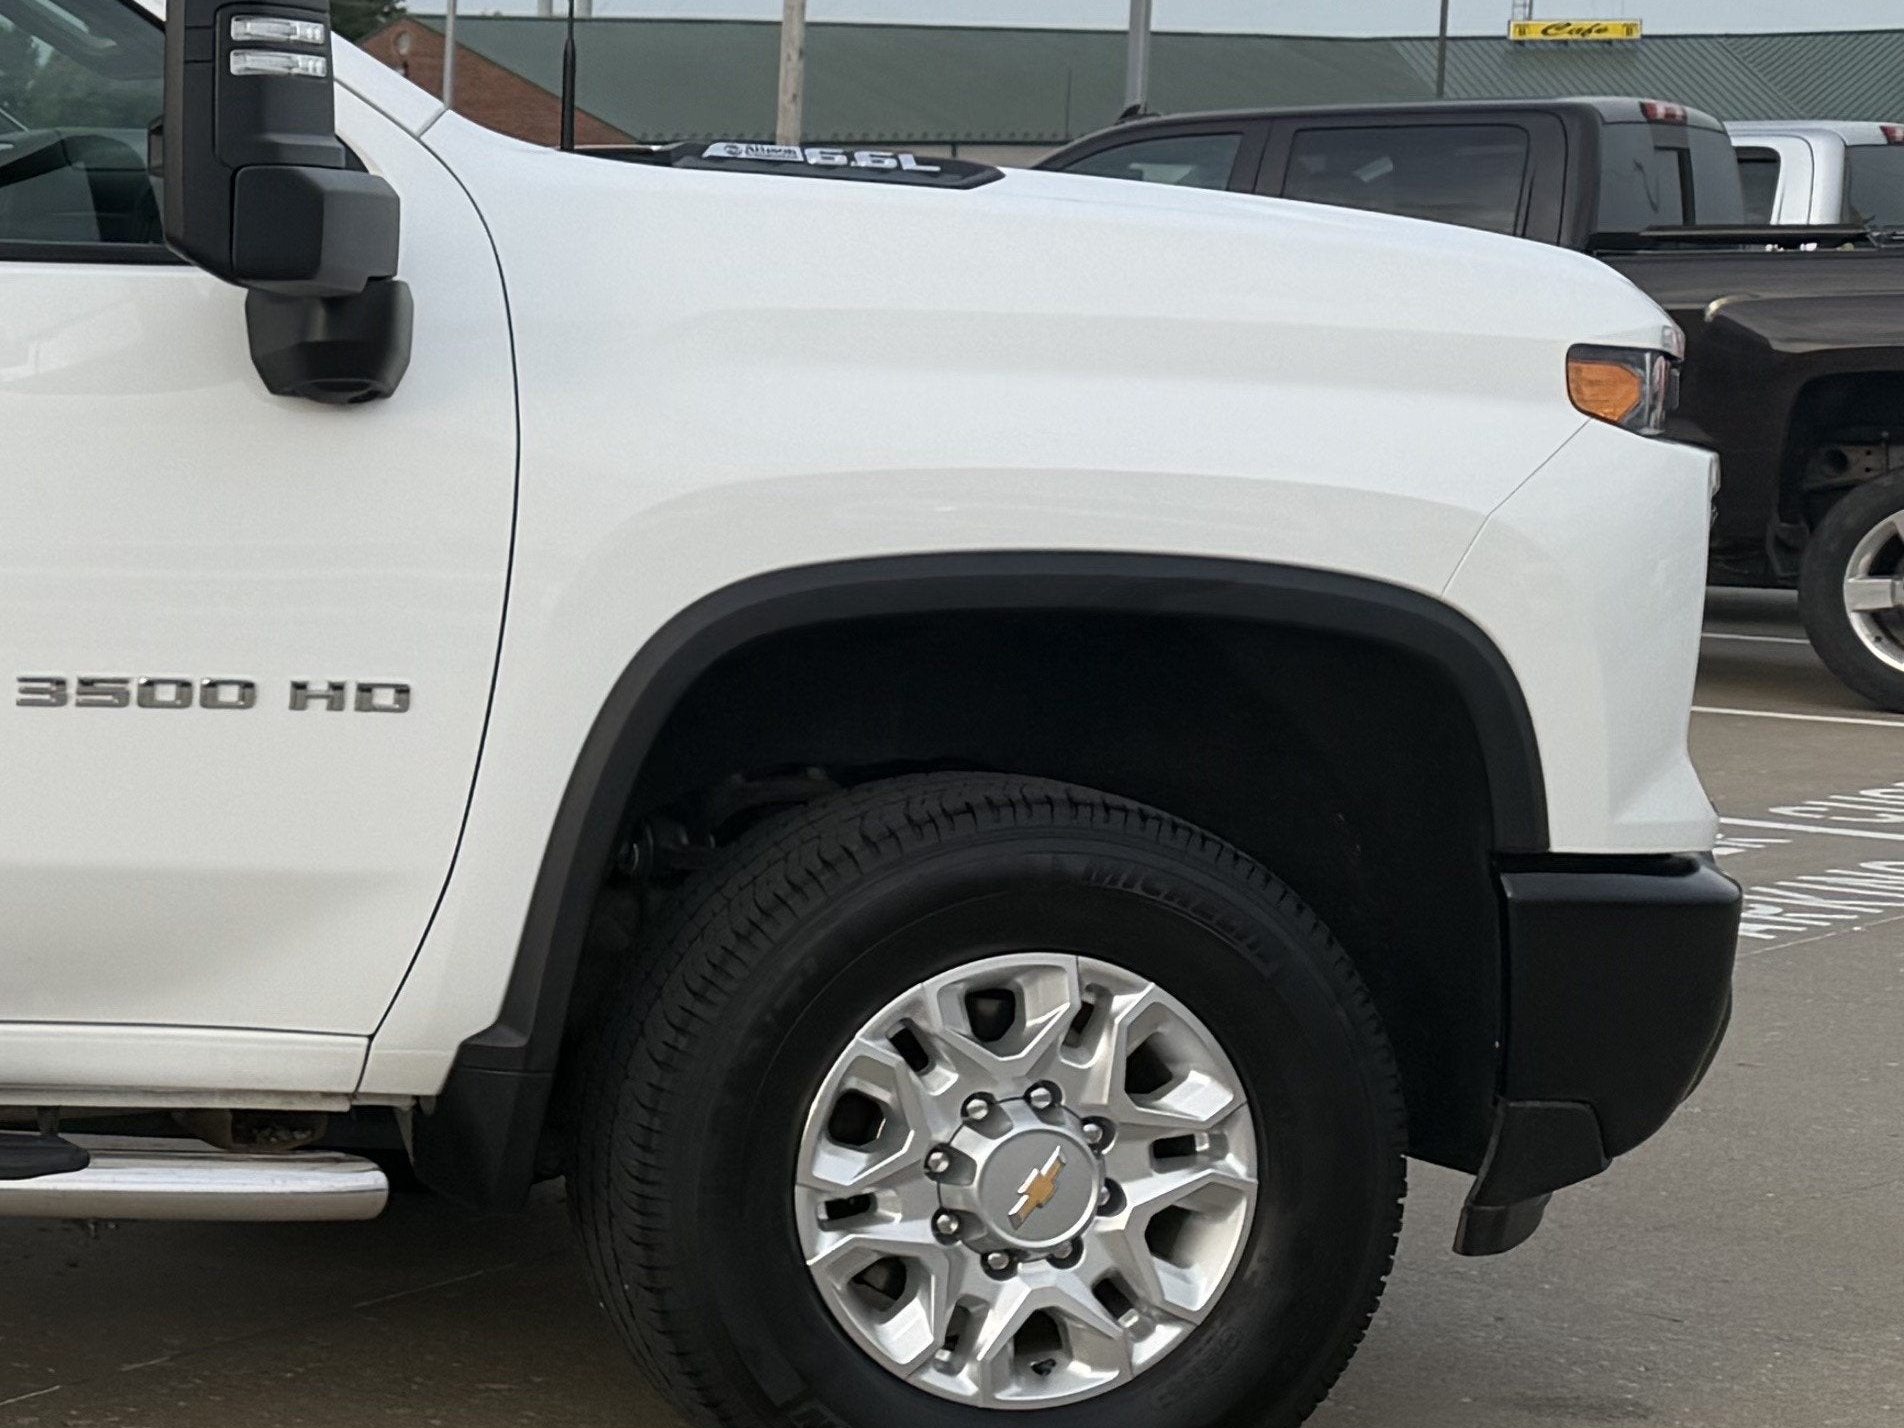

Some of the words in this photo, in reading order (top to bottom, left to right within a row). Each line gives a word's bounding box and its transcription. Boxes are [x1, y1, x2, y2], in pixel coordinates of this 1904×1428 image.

[804, 147, 942, 172] 6.6L
[15, 676, 257, 710] 3500
[287, 679, 411, 713] HD
